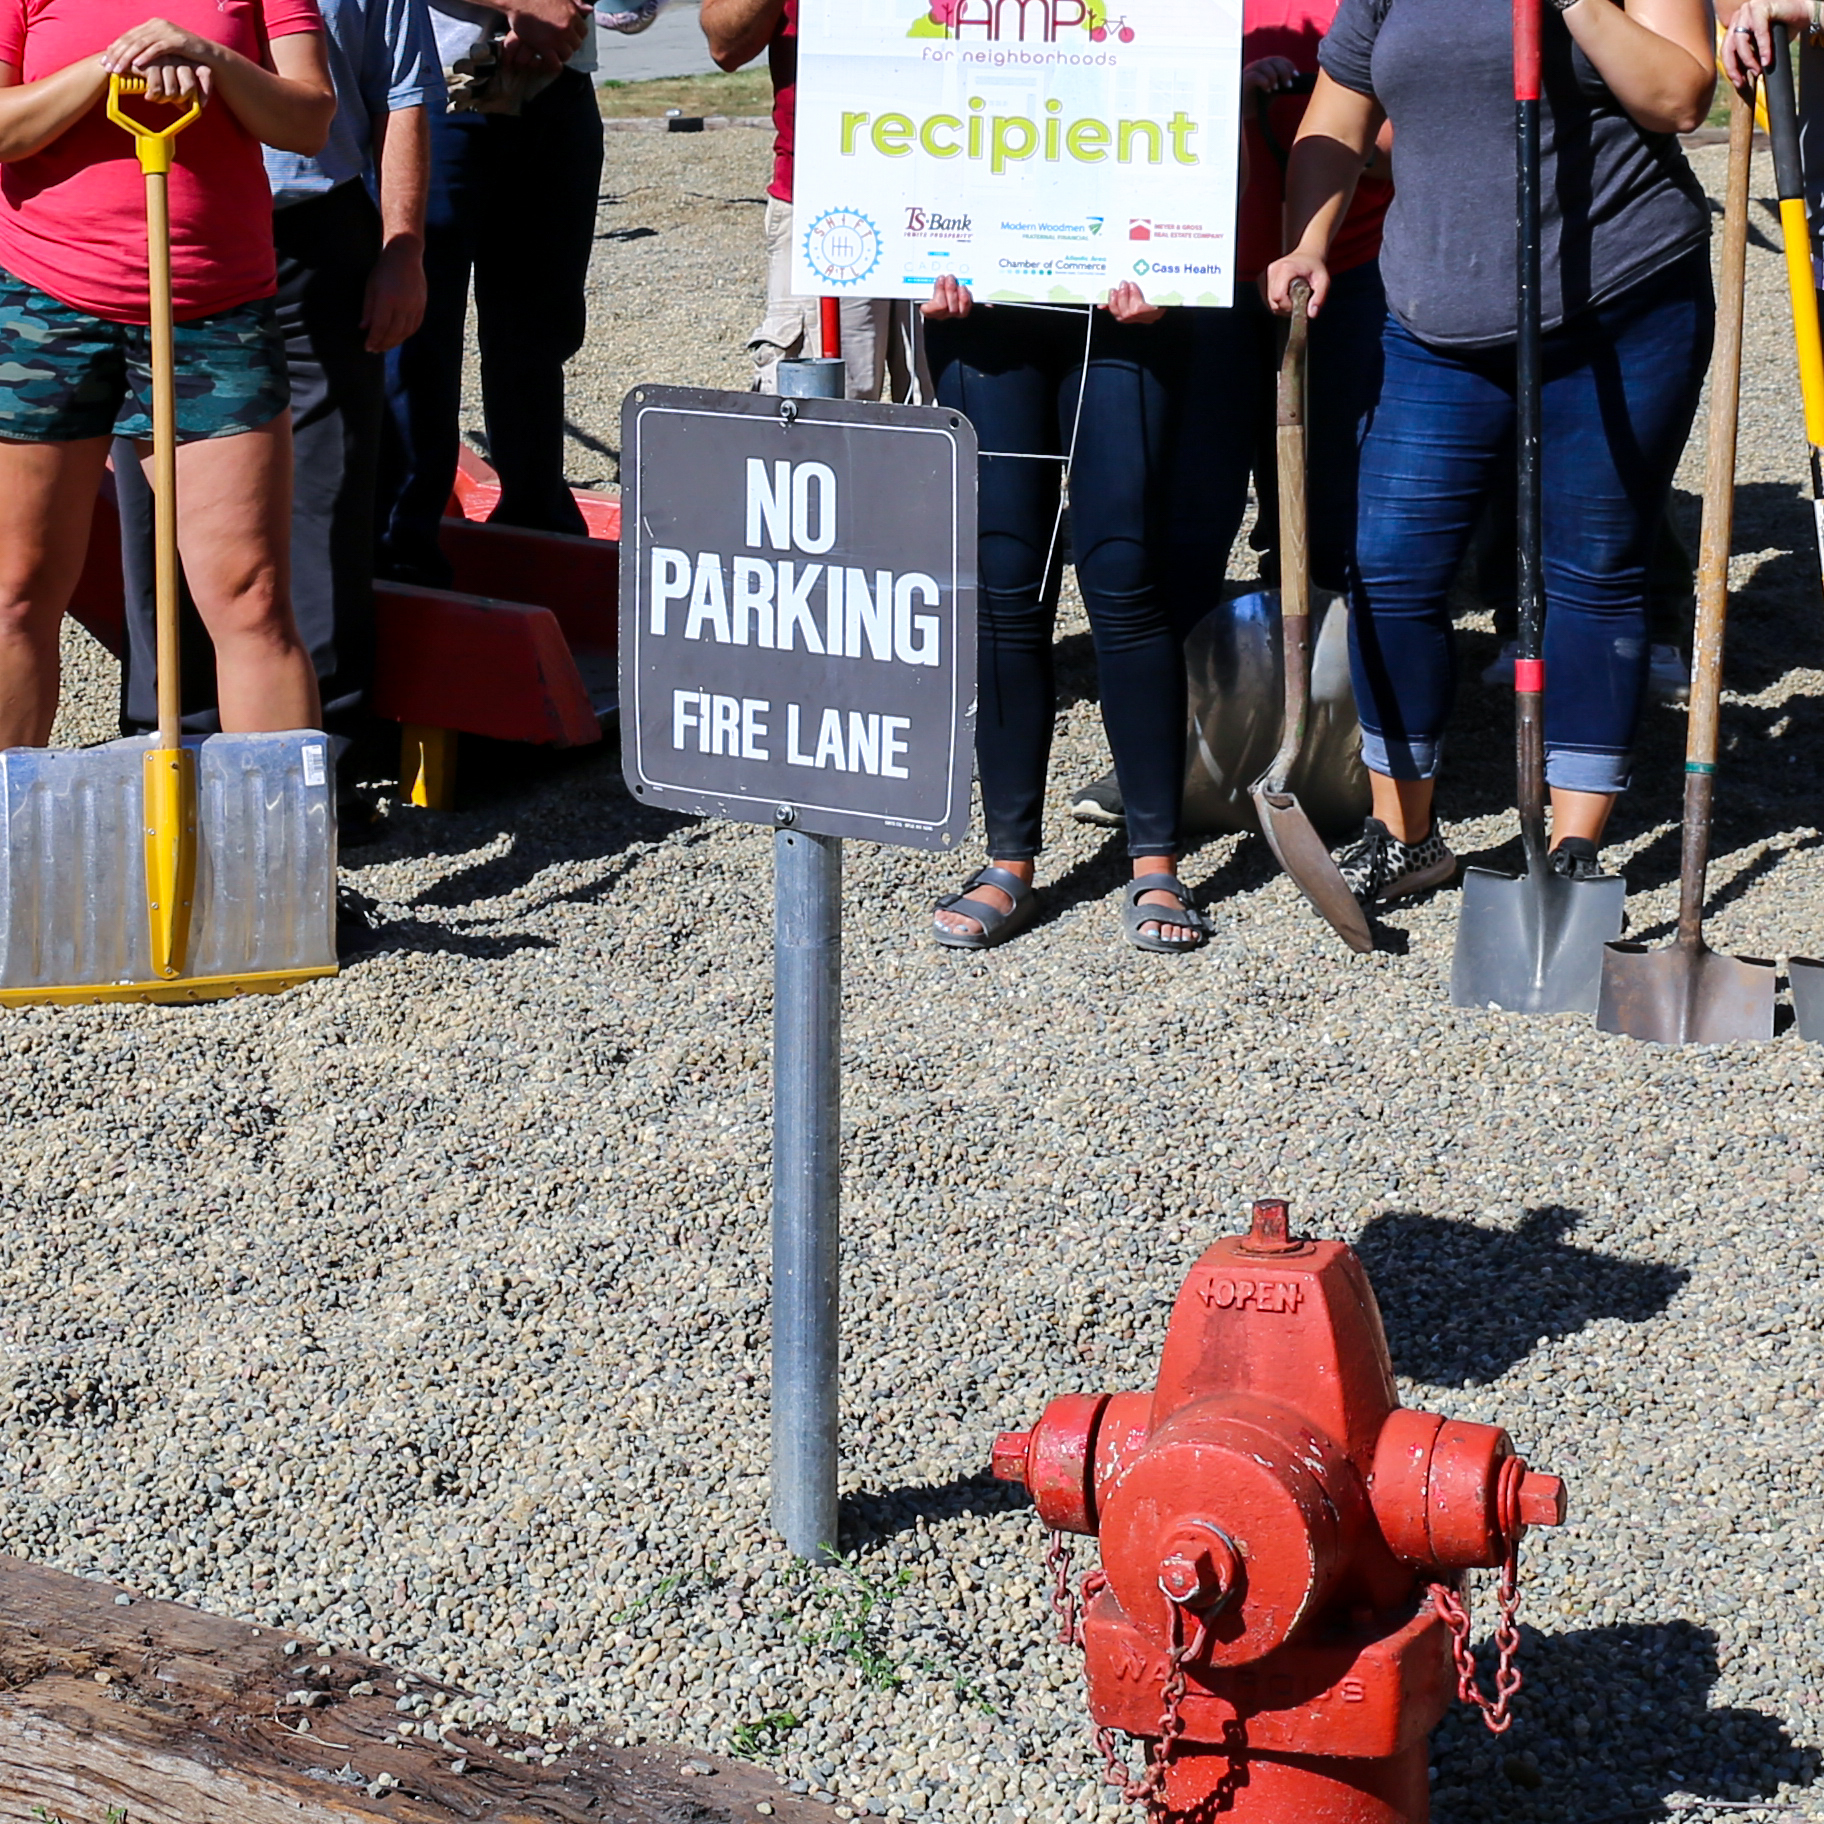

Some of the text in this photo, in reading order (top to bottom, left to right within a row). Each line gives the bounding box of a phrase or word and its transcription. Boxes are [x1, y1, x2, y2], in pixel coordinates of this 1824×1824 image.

[922, 47, 1117, 67] for neighborhoods
[841, 96, 1201, 175] recipient
[814, 213, 873, 238] SHIFT
[1001, 221, 1085, 233] Modern Woodmen
[903, 260, 971, 274] CADCO
[998, 258, 1107, 271] Chamber of Commerce
[1152, 262, 1221, 274] Cass Health
[746, 457, 837, 555] NO
[650, 546, 941, 667] PARKING
[673, 689, 911, 780] FIRE LANE
[1214, 1278, 1300, 1314] OPEN
